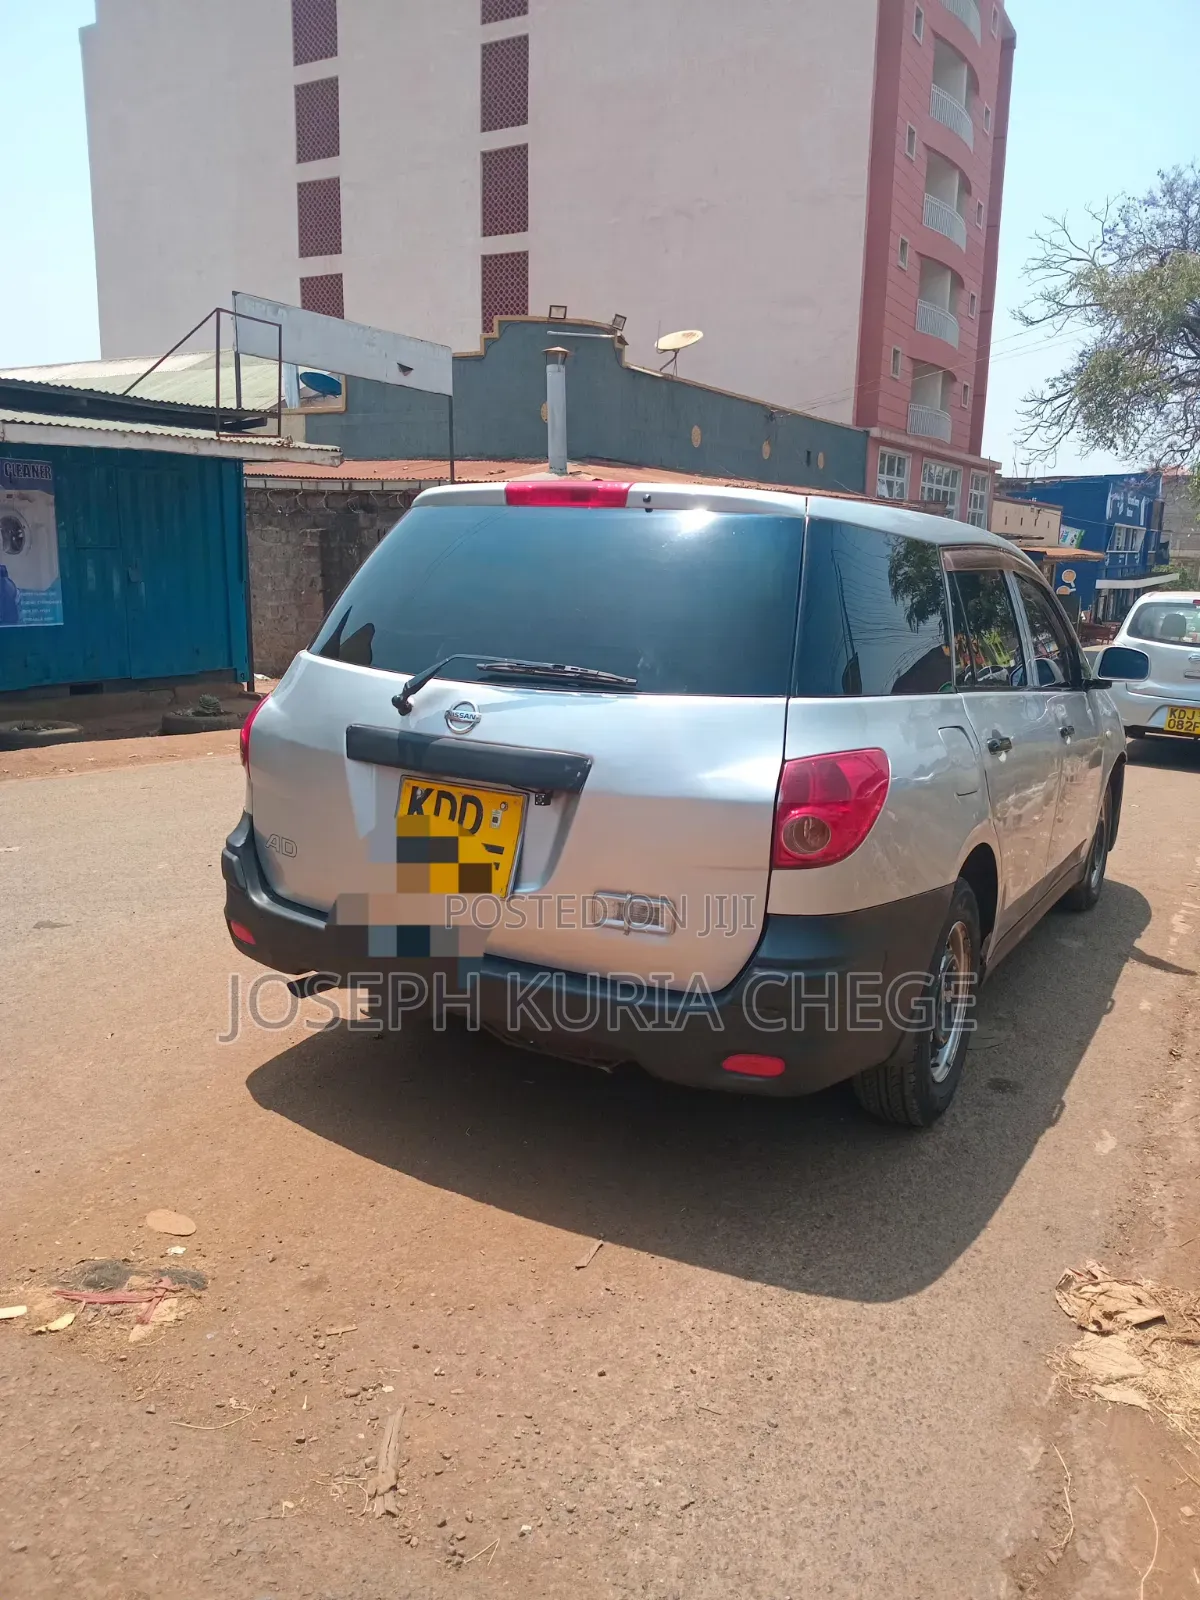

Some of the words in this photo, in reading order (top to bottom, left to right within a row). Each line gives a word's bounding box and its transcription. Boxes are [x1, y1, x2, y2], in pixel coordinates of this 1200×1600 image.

[4, 461, 52, 480] CLEANER
[448, 711, 477, 720] NISSAN
[1169, 707, 1196, 721] KDJ
[264, 833, 298, 858] AD
